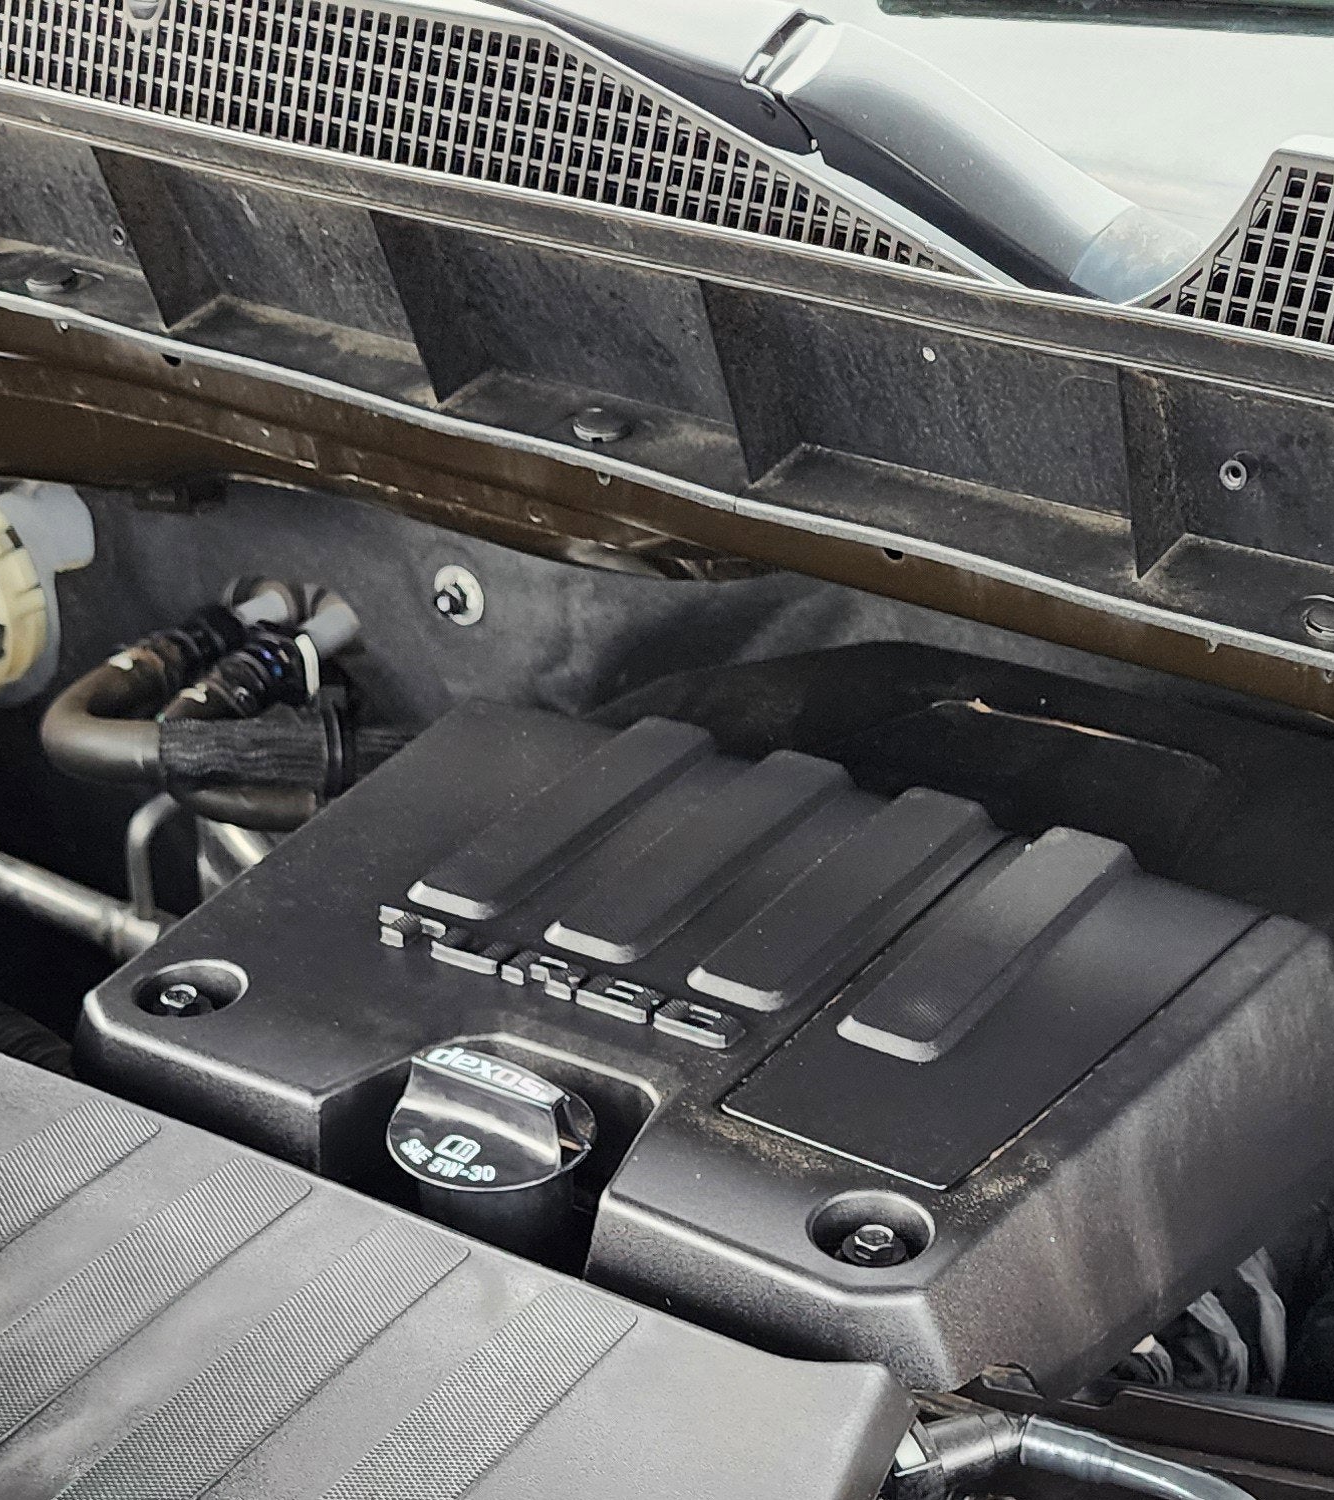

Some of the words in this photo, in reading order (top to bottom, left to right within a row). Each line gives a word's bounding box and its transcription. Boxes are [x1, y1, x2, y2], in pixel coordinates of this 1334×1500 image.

[426, 1046, 547, 1104] dexos
[399, 1138, 434, 1165] SAE
[427, 1157, 496, 1182] 5W-30
